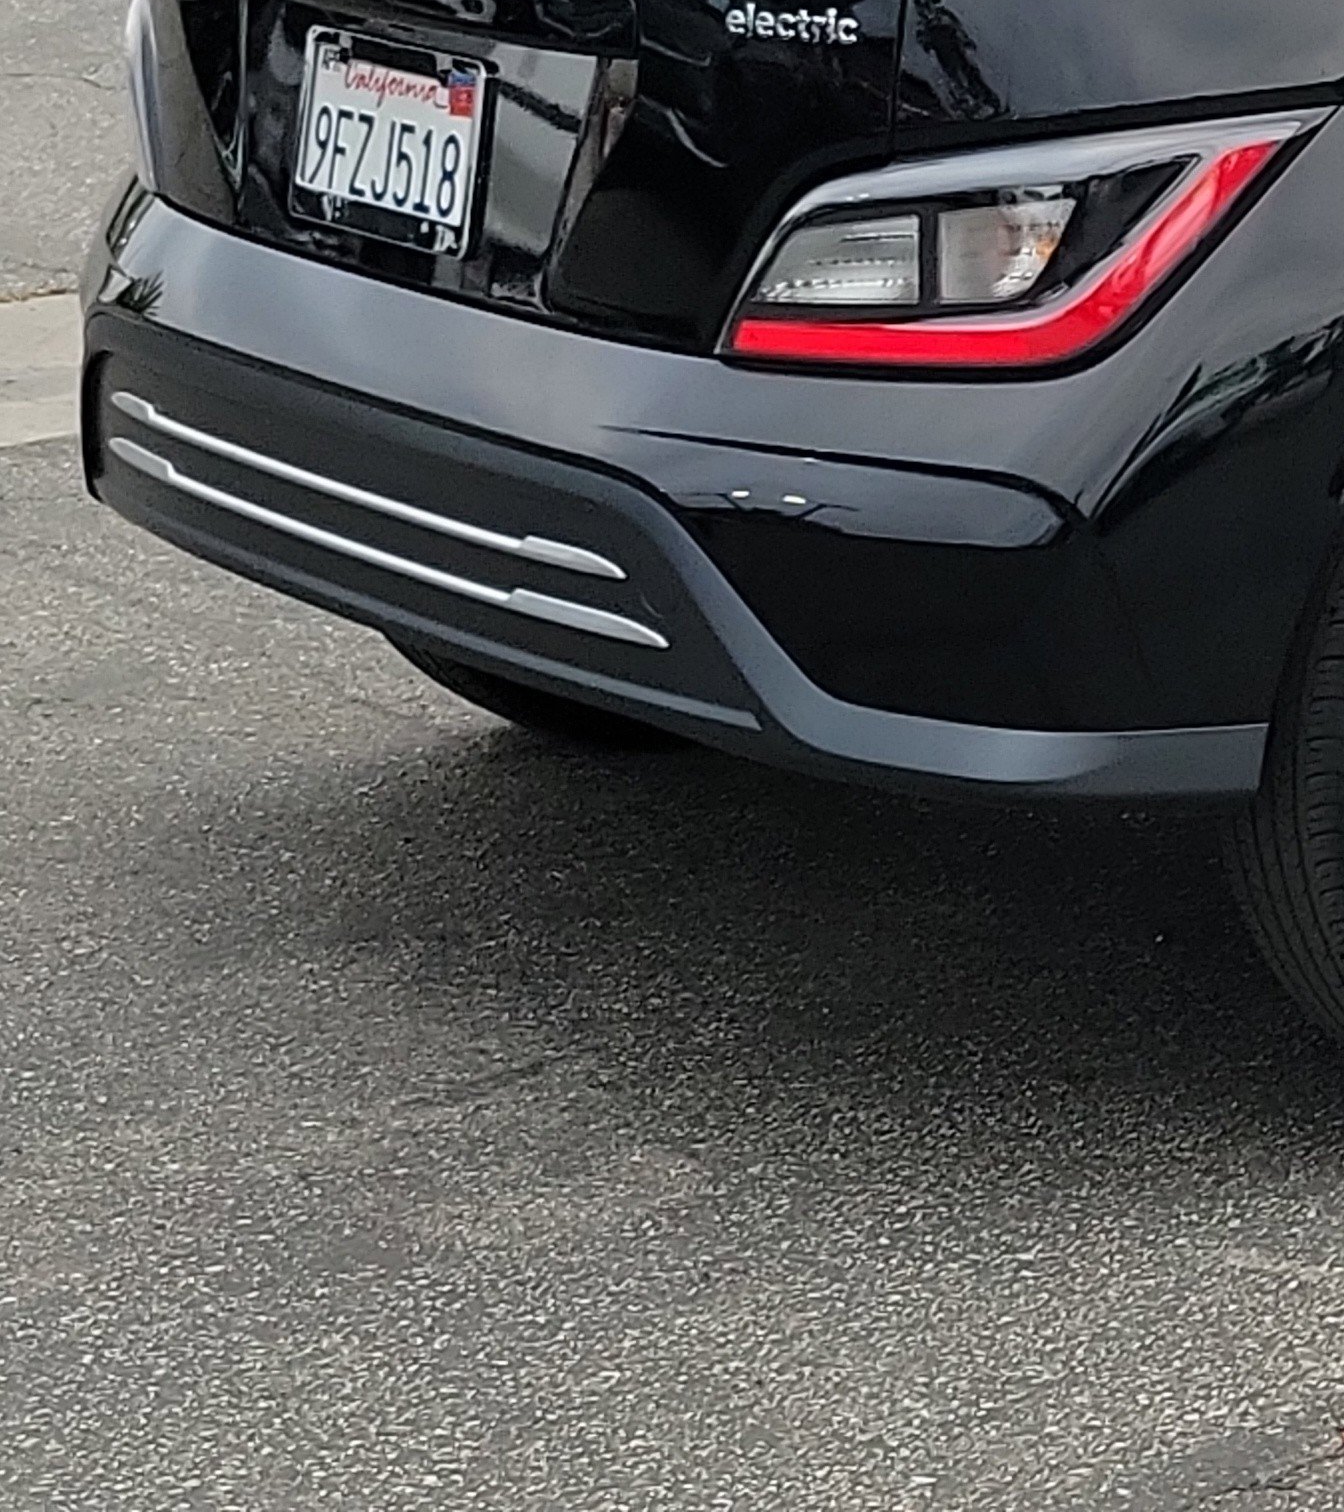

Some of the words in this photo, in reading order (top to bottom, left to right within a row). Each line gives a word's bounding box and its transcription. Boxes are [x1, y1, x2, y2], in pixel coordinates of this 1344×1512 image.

[725, 2, 859, 44] electric
[345, 59, 448, 109] California
[308, 105, 460, 217] 9FZJ518
